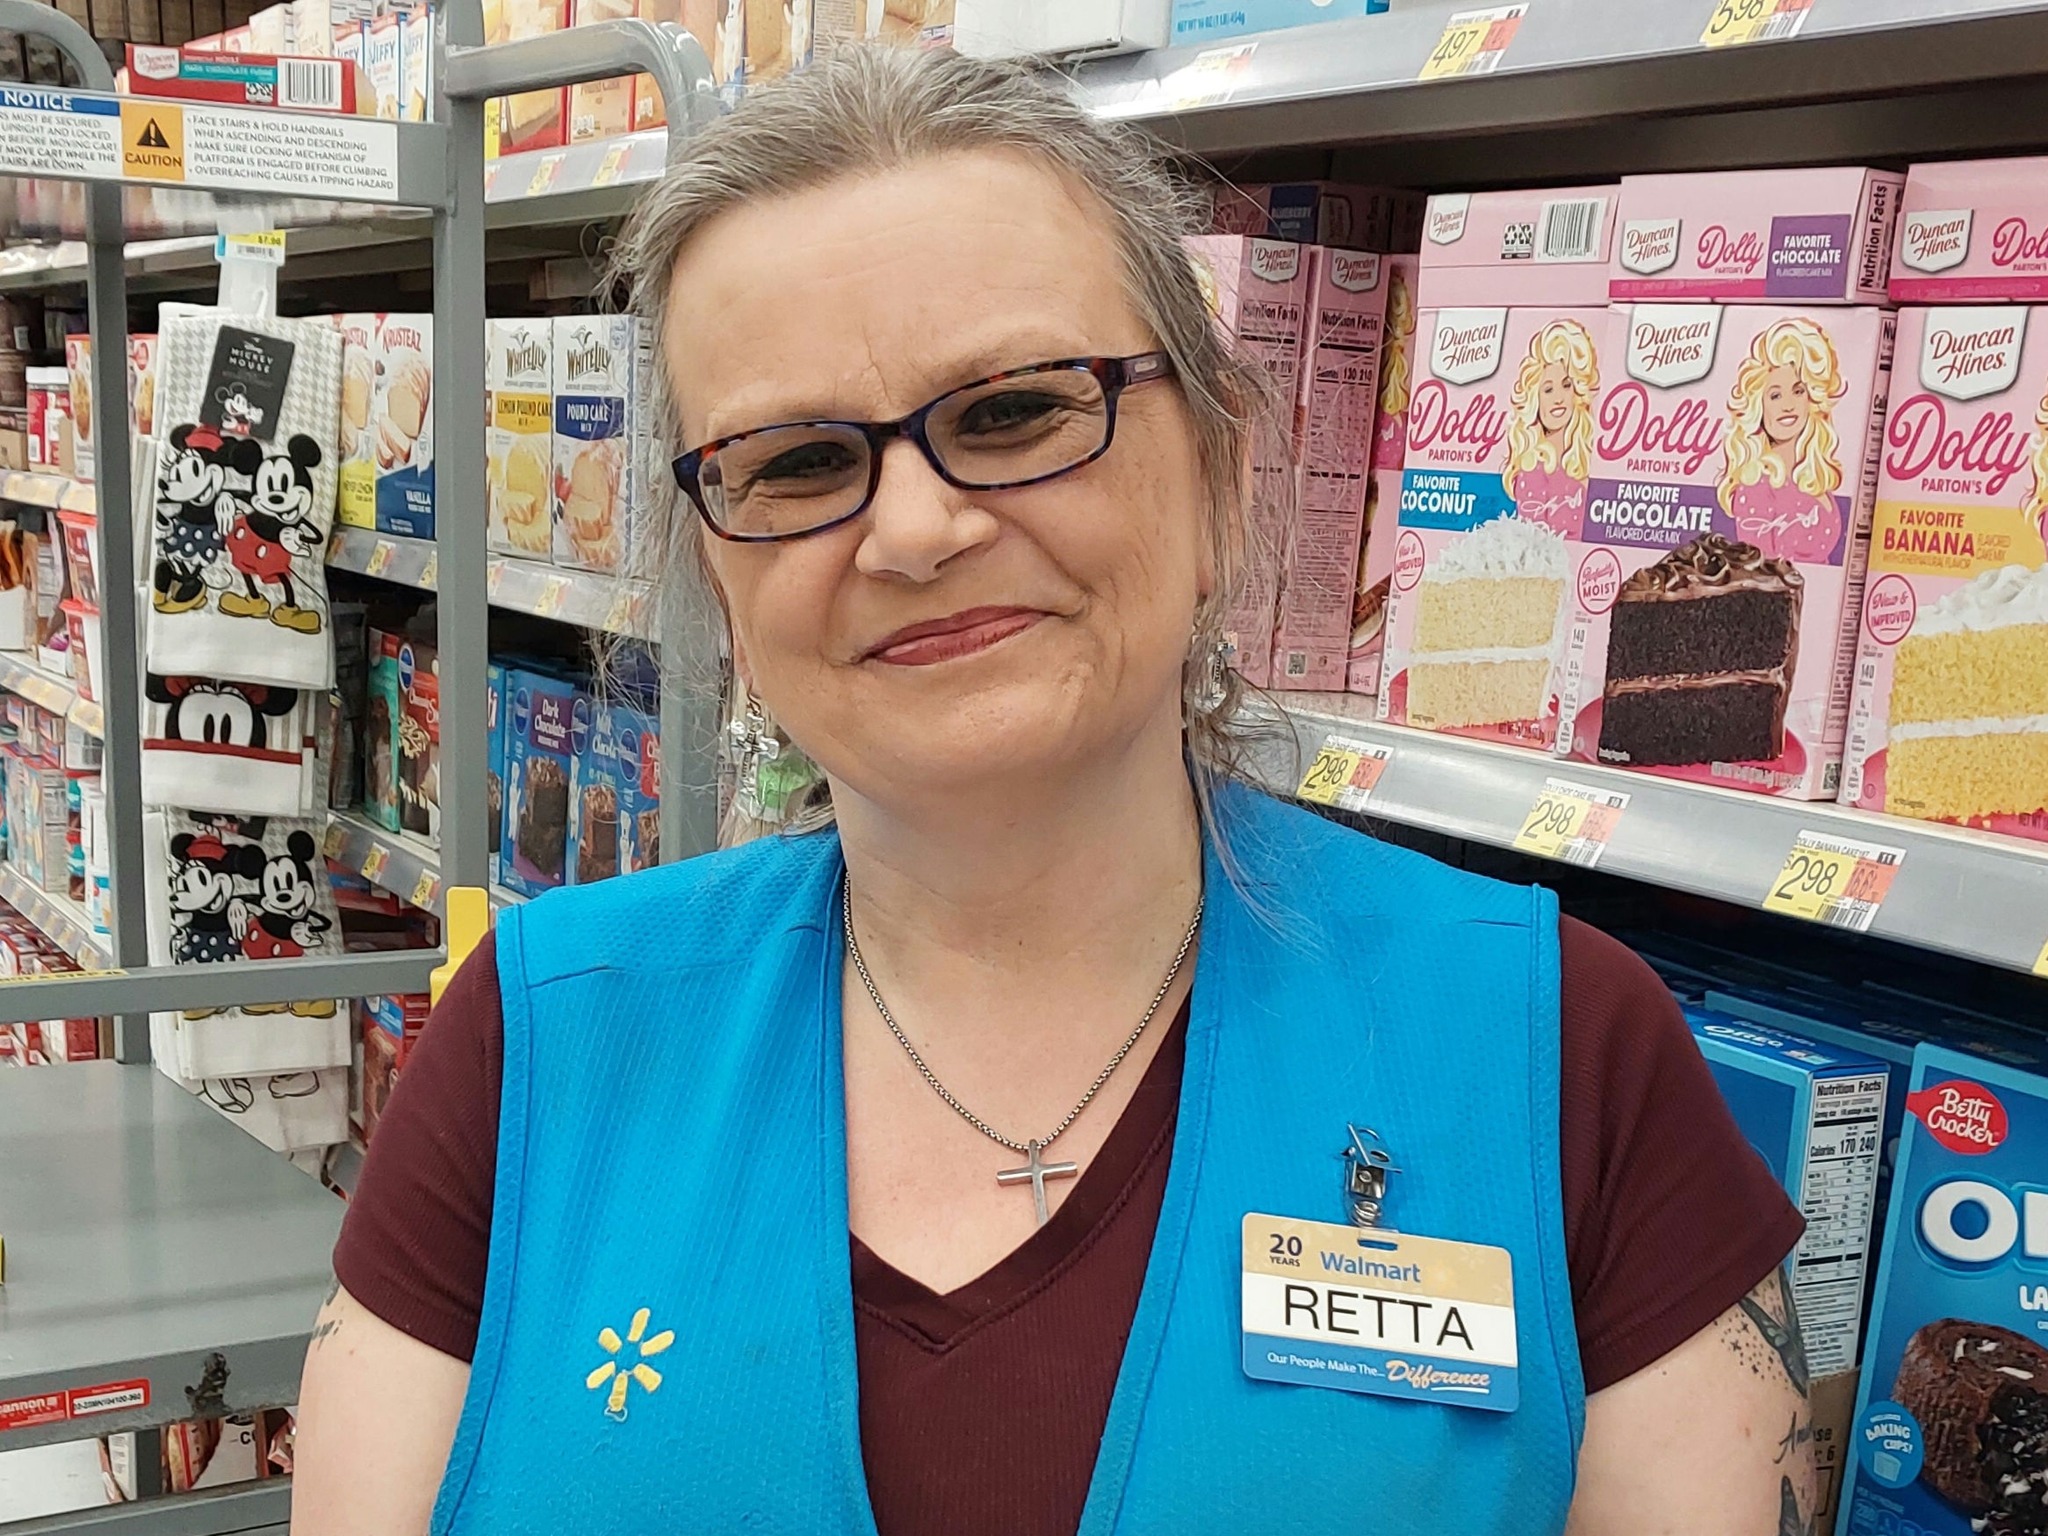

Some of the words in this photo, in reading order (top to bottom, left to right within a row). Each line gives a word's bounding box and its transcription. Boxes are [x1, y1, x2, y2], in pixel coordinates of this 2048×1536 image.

[369, 40, 395, 64] JIFFY
[4, 90, 73, 111] NOTICE
[11, 112, 38, 122] MUST
[41, 115, 53, 124] BE
[55, 116, 100, 128] SECURED
[193, 115, 217, 126] FACE
[219, 117, 250, 129] STAIRS
[253, 120, 260, 129] &
[262, 121, 289, 132] HOLD
[291, 124, 344, 137] HANDRAILS
[2, 123, 44, 134] UPRIGHT
[50, 127, 69, 136] AND
[72, 128, 111, 140] LOCKED
[8, 135, 46, 146] BEFORE
[50, 138, 91, 149] MOVING
[93, 141, 117, 150] CART
[194, 129, 224, 139] WHEN
[226, 131, 282, 145] ASCENDING
[284, 135, 305, 146] AND
[307, 137, 367, 151] DESCENDING
[6, 145, 36, 155] MOVE
[37, 148, 63, 158] CART
[66, 150, 95, 161] WHILE
[97, 153, 116, 163] THE
[31, 158, 49, 168] ARE
[125, 152, 182, 168] CAUTION
[194, 141, 221, 151] MAKE
[223, 143, 248, 154] SURE
[250, 145, 292, 157] LOCKING
[295, 148, 351, 162] MECHANISM
[353, 154, 367, 163] OF
[194, 152, 244, 165] PLATFORM
[247, 157, 255, 166] IS
[257, 158, 303, 171] ENGAGED
[305, 161, 340, 173] BEFORE
[343, 165, 388, 177] CLIMBING
[194, 166, 271, 180] OVERREACHING
[273, 171, 309, 183] CAUSES
[311, 174, 317, 183] A
[319, 175, 355, 187] TIPPING
[357, 179, 394, 190] HAZARD
[1870, 185, 1888, 225] Facts
[1626, 225, 1675, 249] Duncan
[1783, 233, 1832, 249] FAVORITE
[1908, 219, 1965, 245] Duncan
[1255, 245, 1296, 263] Duncan
[1631, 242, 1671, 265] Hines
[1697, 225, 1765, 274] Dolly
[1771, 248, 1842, 266] CHOCOLATE
[1860, 228, 1882, 289] Nutrition
[1914, 237, 1961, 262] Hines
[1335, 256, 1376, 273] Duncan
[1321, 311, 1356, 330] Nutrition
[1356, 314, 1378, 331] Facts
[383, 328, 422, 354] KRUSTEAZ
[1438, 323, 1498, 351] Duncan
[1635, 320, 1711, 350] Duncan
[1930, 325, 2015, 360] Duncan
[229, 357, 270, 374] MOUSE
[232, 347, 274, 365] MICKEY
[1442, 344, 1491, 371] Hines
[1641, 343, 1702, 372] Hines
[1937, 350, 2005, 384] Hines
[567, 403, 589, 422] POUND
[590, 403, 609, 423] CAKE
[1409, 379, 1508, 463] Dolly
[1596, 381, 1724, 475] Dolly
[1428, 449, 1472, 463] PARTON'S
[1886, 394, 2031, 496] Dolly
[1626, 458, 1680, 474] PARTON'S
[1413, 475, 1461, 491] FAVORITE
[1617, 483, 1681, 503] FAVORITE
[1921, 477, 1982, 495] PARTON'S
[1401, 489, 1477, 516] COCONUT
[1589, 499, 1713, 531] CHOCOLATE
[1900, 509, 1966, 529] FAVORITE
[1605, 526, 1644, 543] FLAVORED
[1643, 528, 1666, 543] CAKE
[1665, 530, 1681, 544] MIX
[1883, 527, 1975, 558] BANANA
[1583, 582, 1617, 598] MOIST
[1871, 610, 1911, 628] IMPROVED
[541, 698, 560, 719] Dark
[534, 716, 566, 739] Chocolate
[1703, 1025, 1784, 1048] OREO
[1817, 1084, 1855, 1097] Nutrition
[1858, 1080, 1882, 1093] Facts
[1939, 1088, 1994, 1129] Betty
[1927, 1105, 2000, 1147] Crocker
[1841, 1137, 1856, 1154] 170
[1859, 1135, 1876, 1153] 240
[1269, 1233, 1303, 1257] 20
[1269, 1255, 1301, 1268] YEARS
[1320, 1250, 1421, 1283] Walmart
[1284, 1284, 1475, 1351] RETTA
[1267, 1351, 1289, 1365] Our
[1289, 1354, 1326, 1371] People
[1327, 1359, 1357, 1374] Make
[1385, 1359, 1490, 1389] Difference
[1865, 1423, 1911, 1441] BAKING
